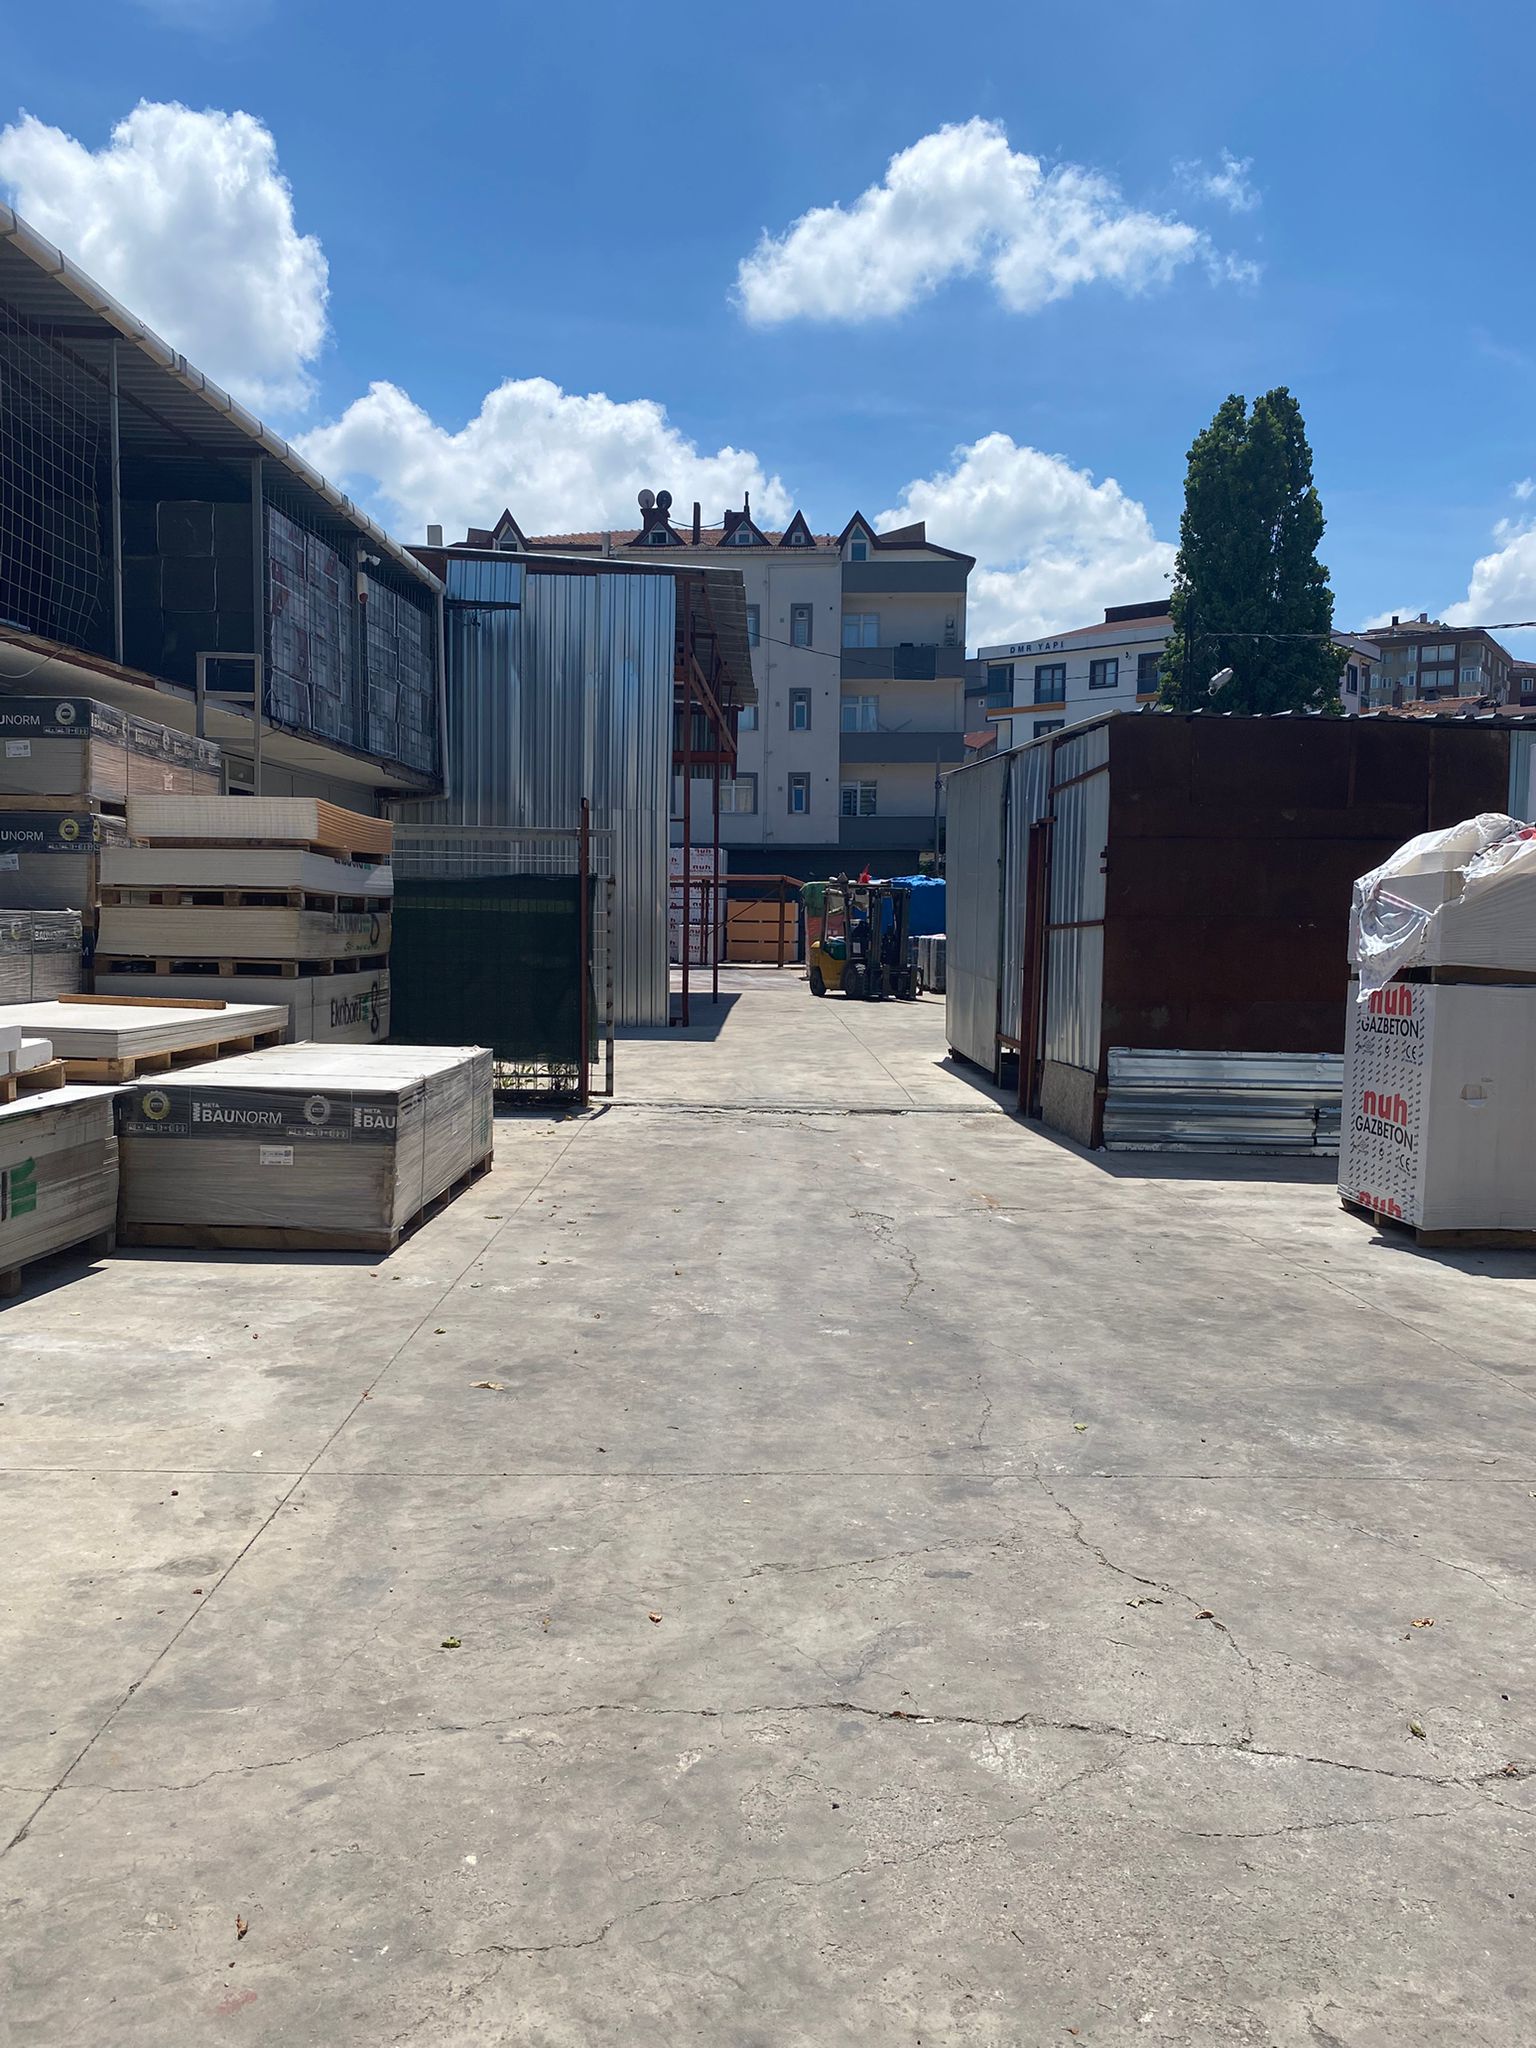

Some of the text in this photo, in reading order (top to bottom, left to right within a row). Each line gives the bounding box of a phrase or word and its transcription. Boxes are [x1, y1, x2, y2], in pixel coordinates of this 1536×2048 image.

[1009, 640, 1064, 654] DMR YAPI
[1368, 984, 1412, 1016] nuh
[1361, 1016, 1419, 1038] GAZBETON
[202, 1109, 283, 1125] BAUNORM
[1363, 1089, 1408, 1127] nuh
[363, 1115, 396, 1129] BAU
[1355, 1115, 1414, 1152] GAZBETON
